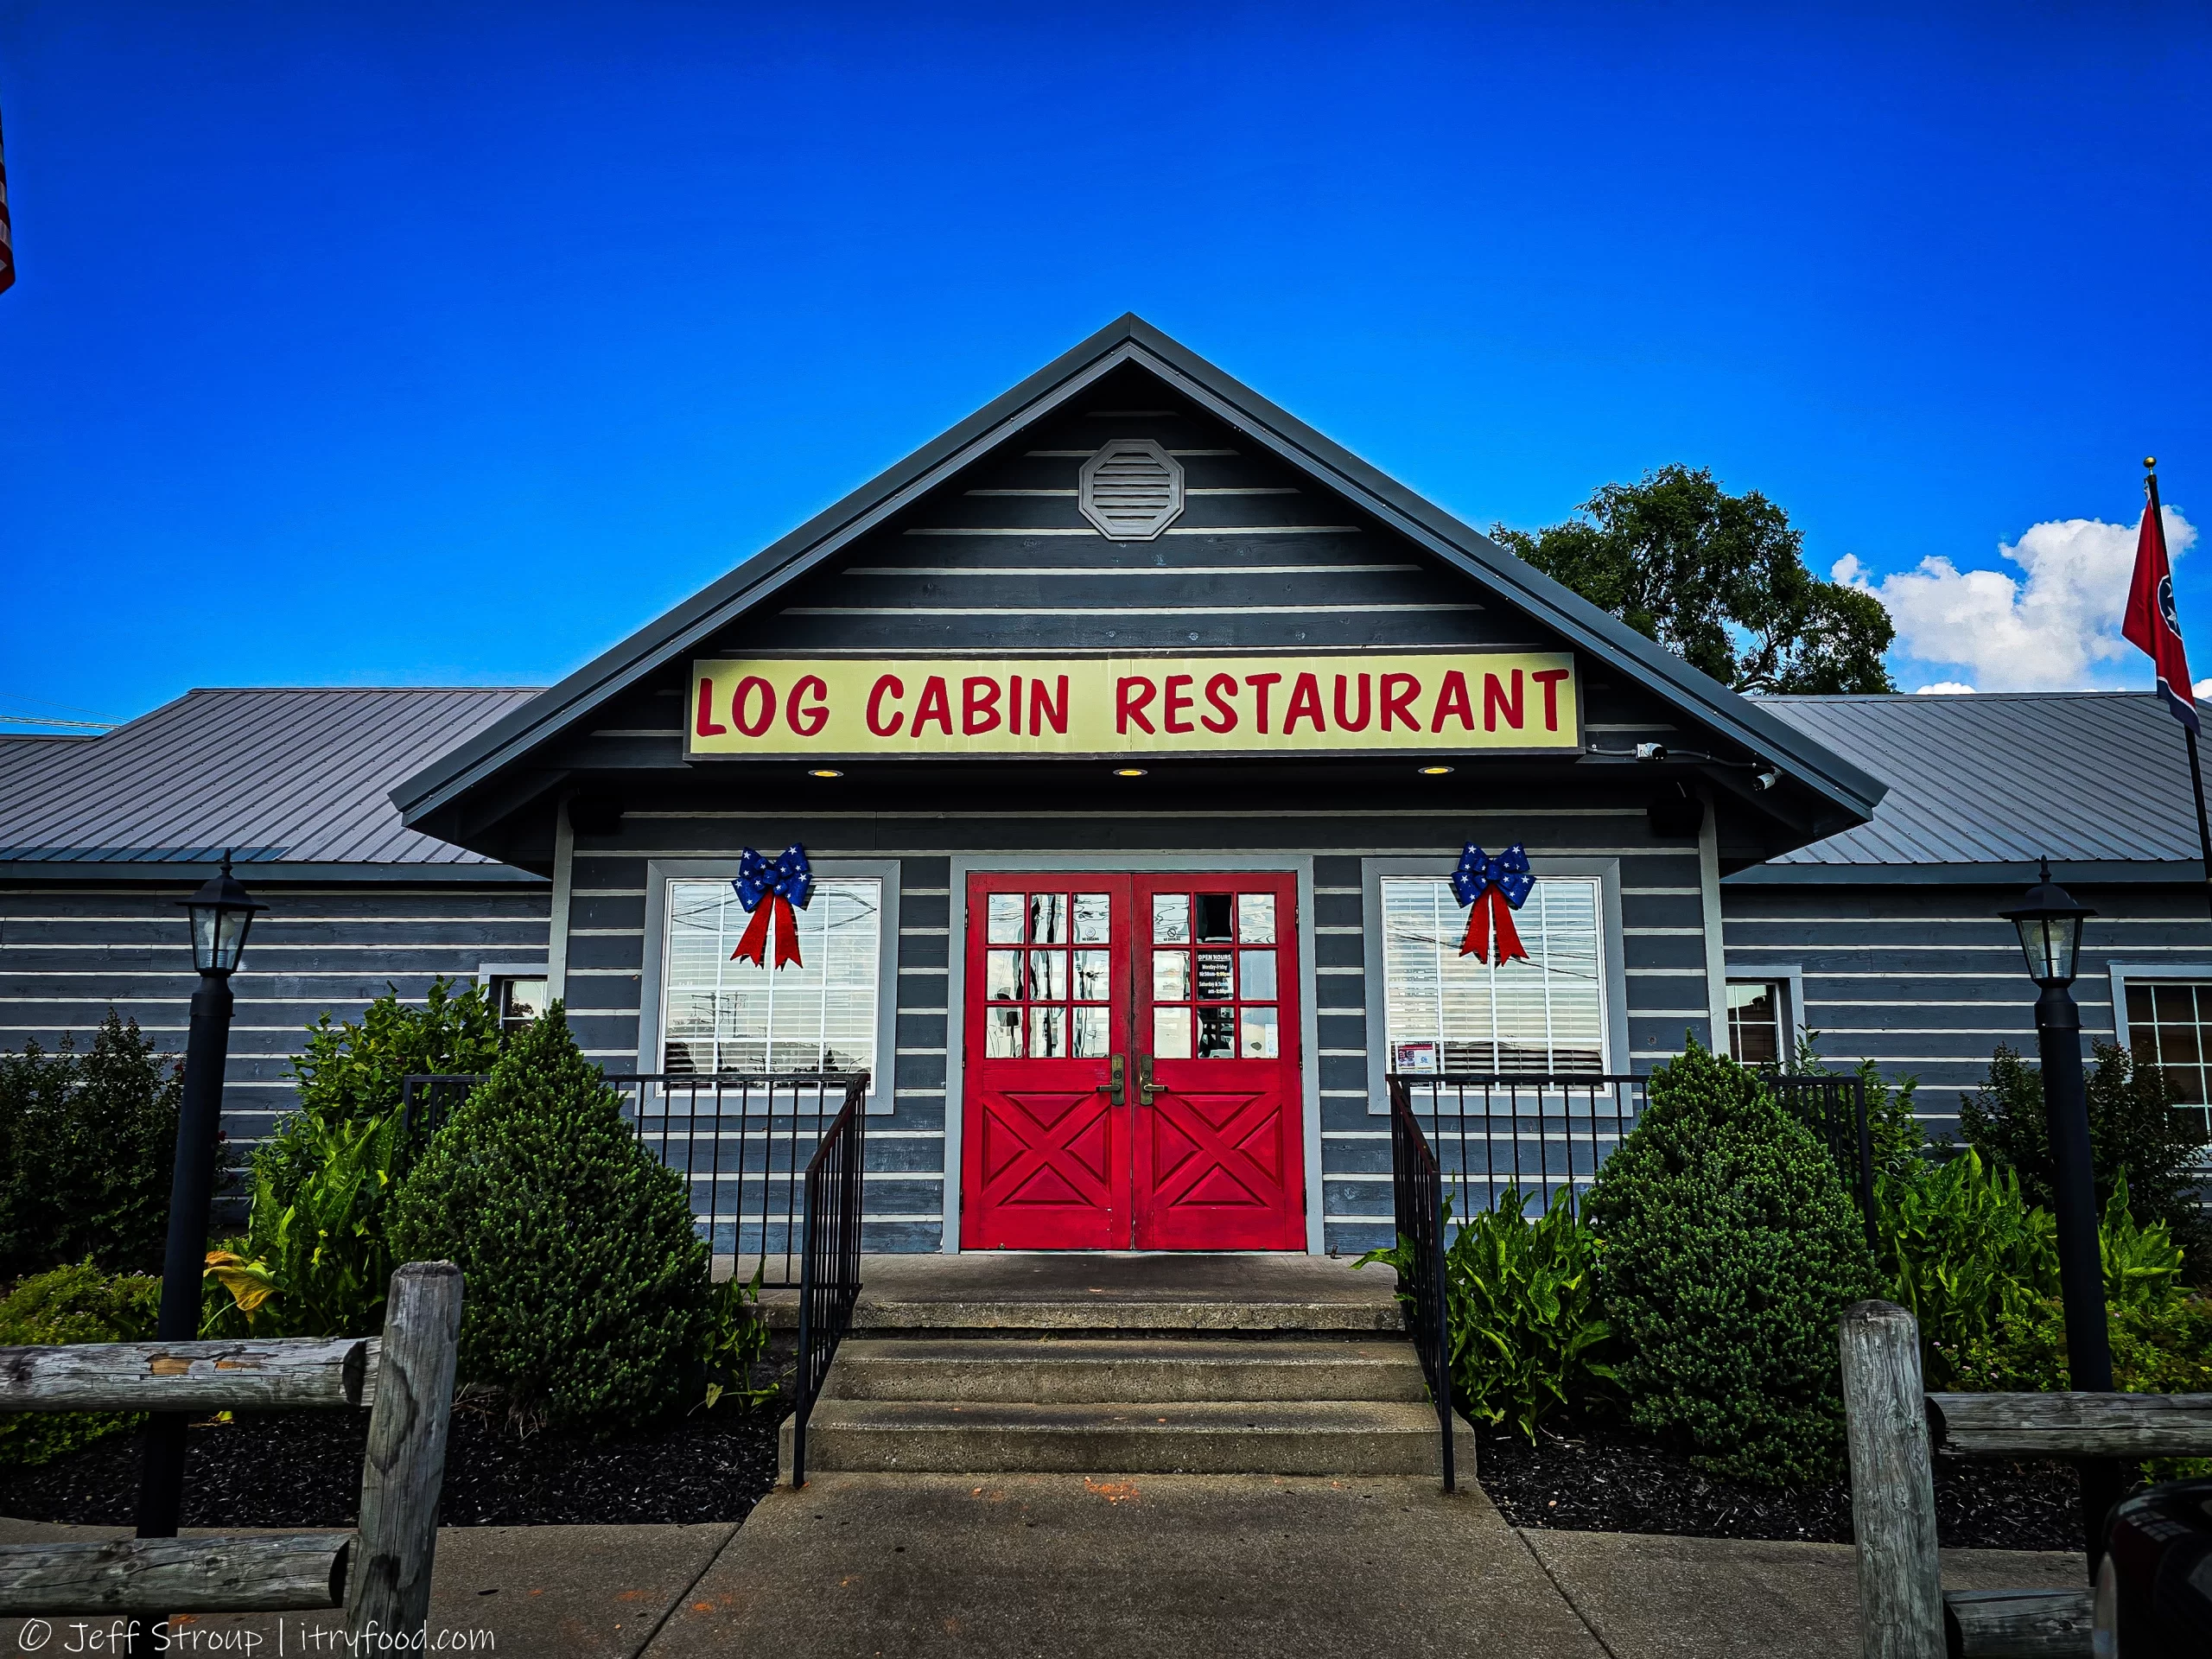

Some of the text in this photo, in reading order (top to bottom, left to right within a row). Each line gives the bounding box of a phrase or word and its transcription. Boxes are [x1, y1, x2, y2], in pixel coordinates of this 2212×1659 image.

[696, 668, 1571, 737] LOG CABIN RESTAURANT
